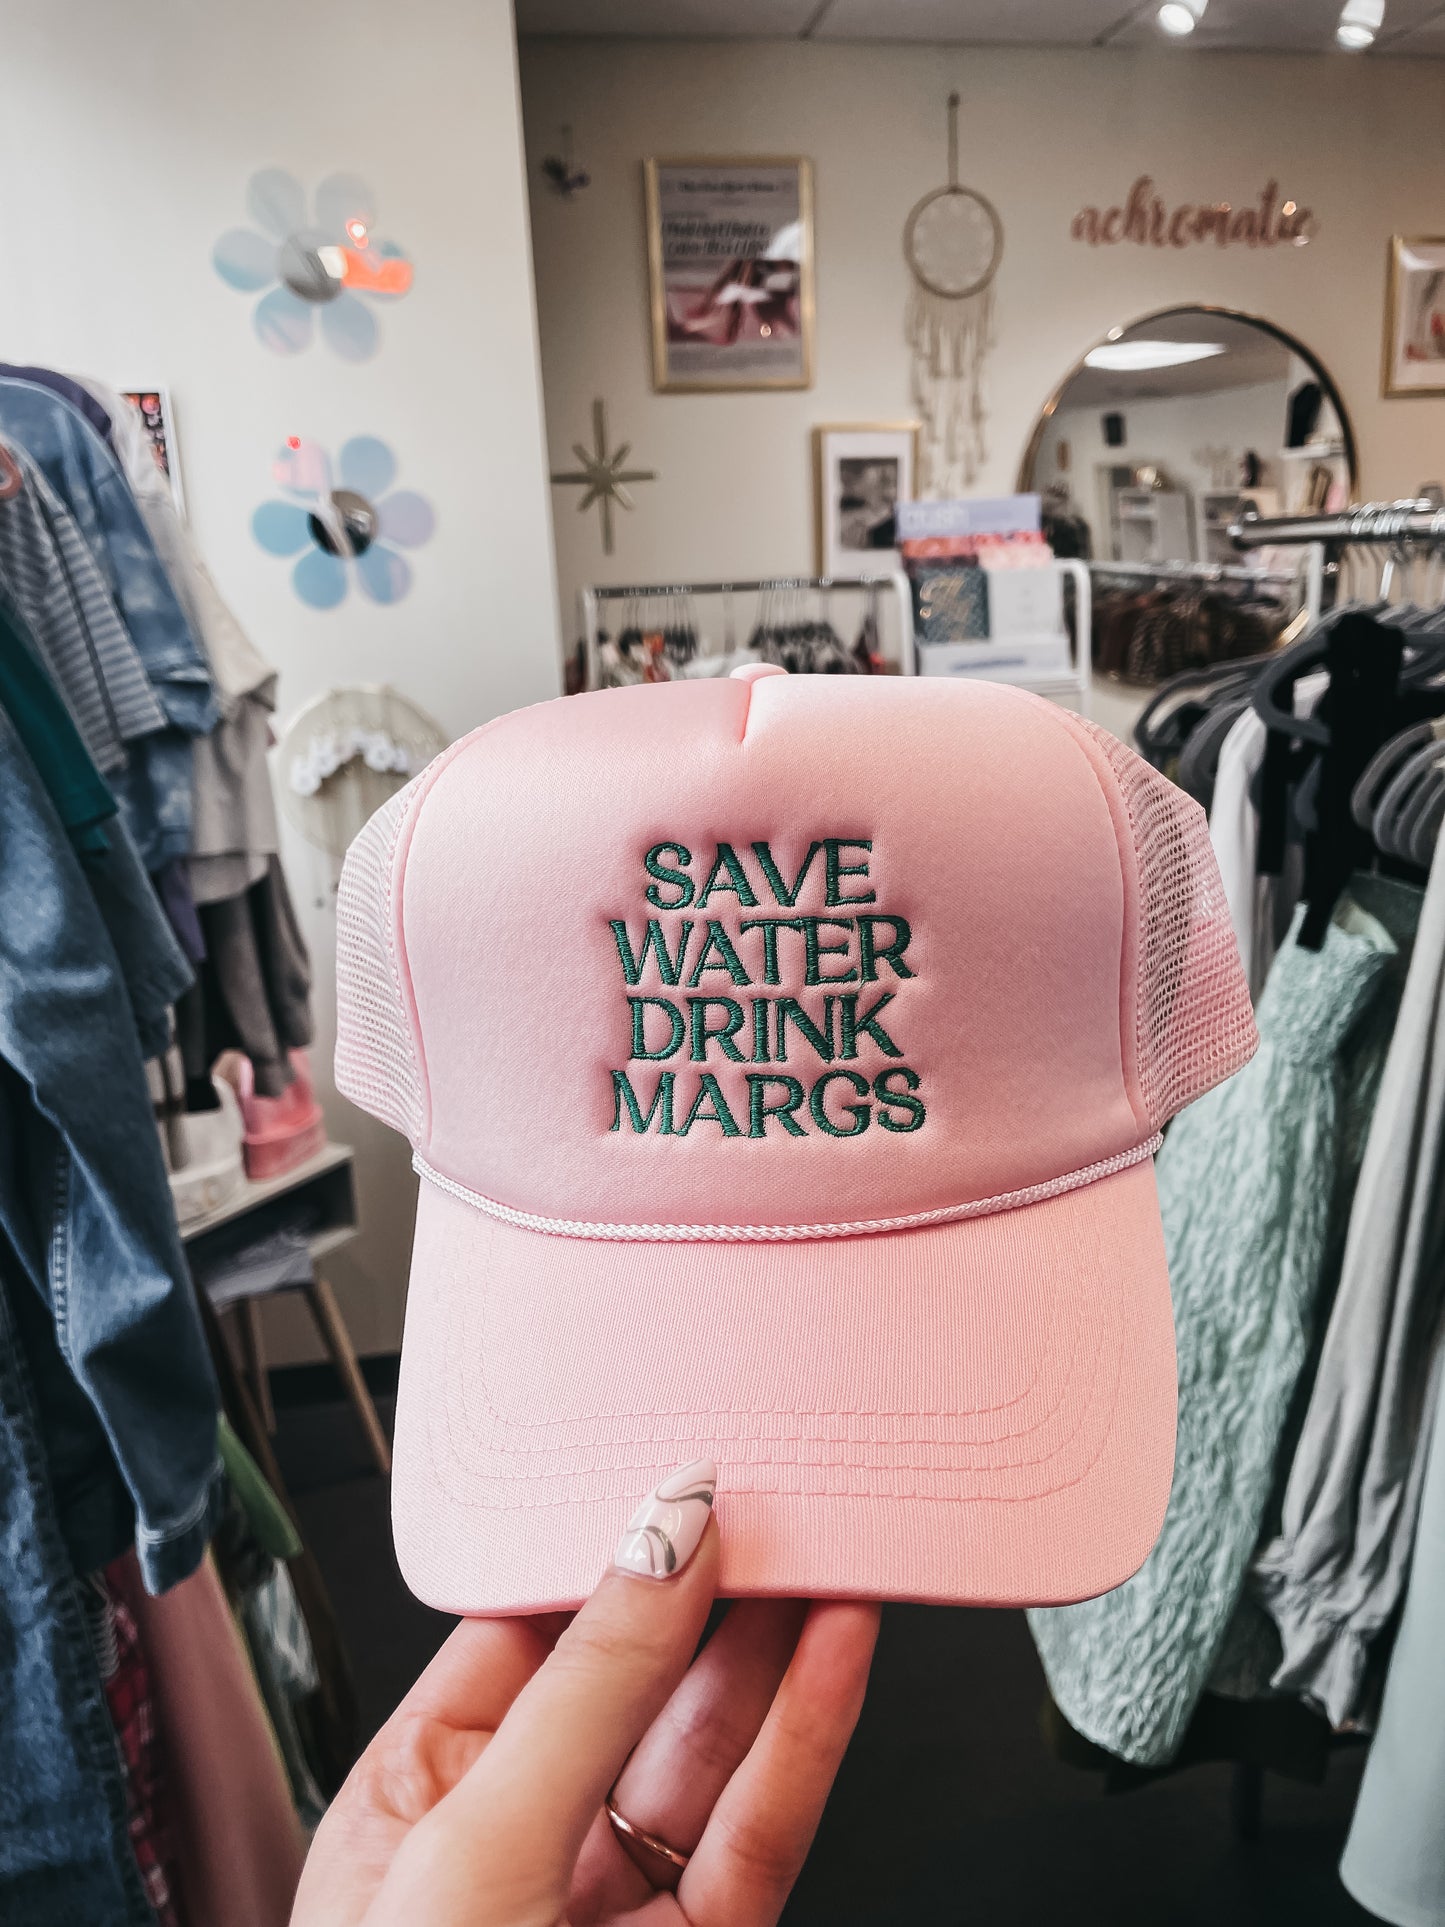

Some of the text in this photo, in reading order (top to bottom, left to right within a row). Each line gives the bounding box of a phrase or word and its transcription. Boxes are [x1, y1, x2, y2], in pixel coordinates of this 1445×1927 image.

[1070, 174, 1319, 248] achromatic
[644, 838, 876, 910] SAVE
[609, 914, 918, 988] WATER
[627, 992, 904, 1064] DRINK
[609, 1067, 926, 1138] MARGS
